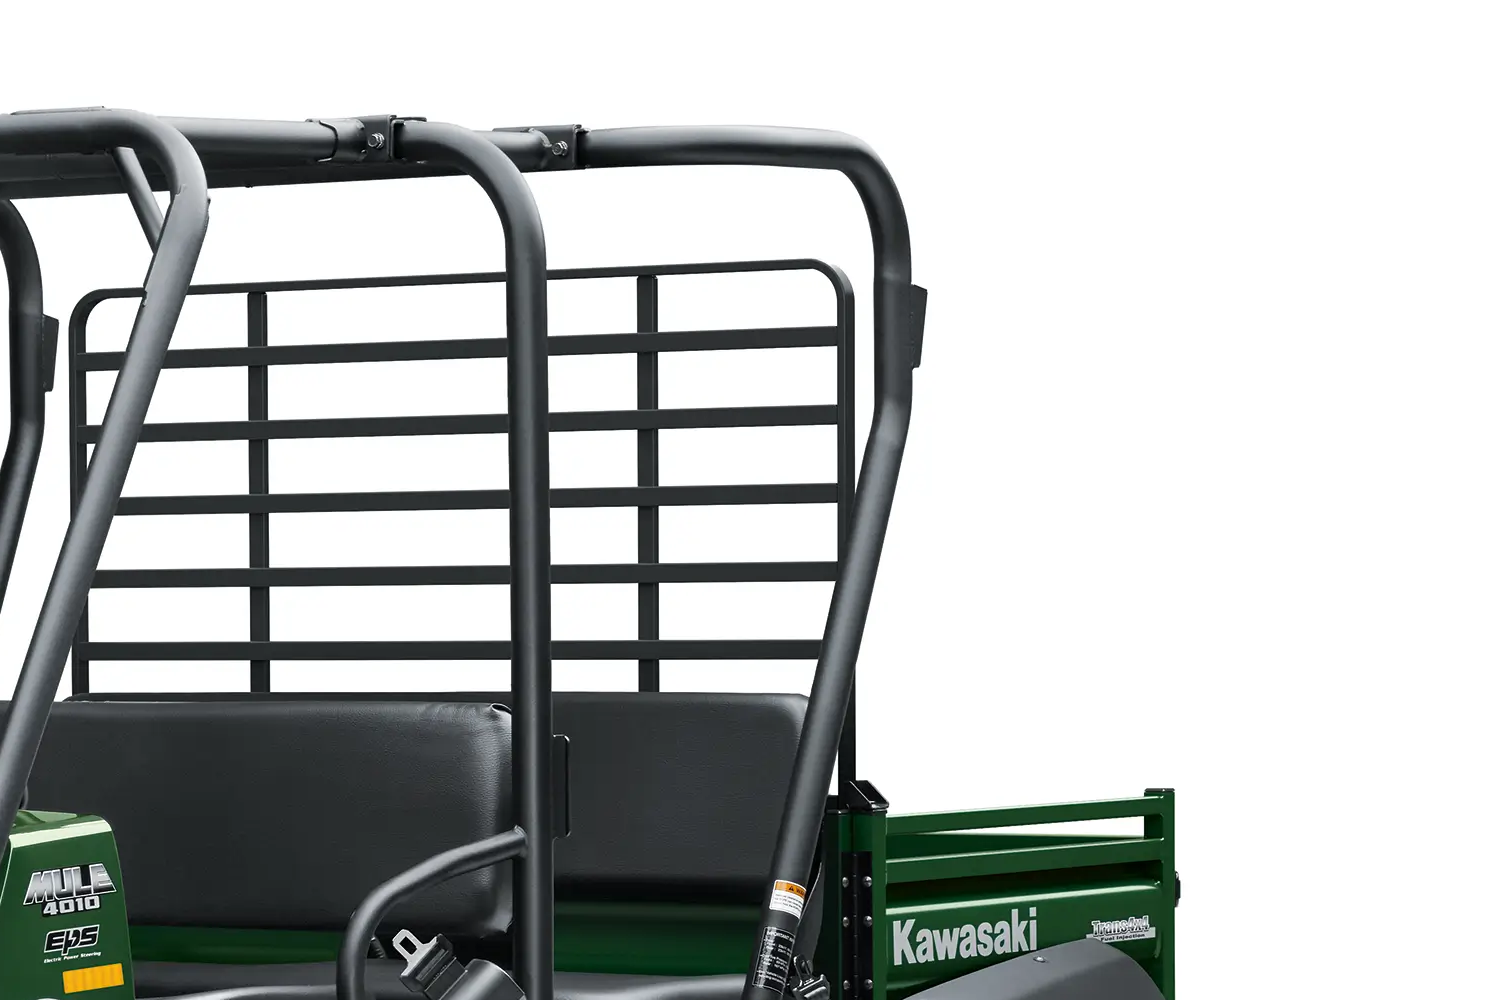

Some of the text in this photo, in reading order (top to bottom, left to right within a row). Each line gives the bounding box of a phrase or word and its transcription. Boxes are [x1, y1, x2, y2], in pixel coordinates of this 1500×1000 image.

[23, 863, 117, 905] MULE
[43, 895, 100, 915] 4010
[893, 907, 1037, 965] Kawasaki
[1091, 915, 1149, 937] Trans4x4
[1100, 932, 1145, 942] Fuel Injection
